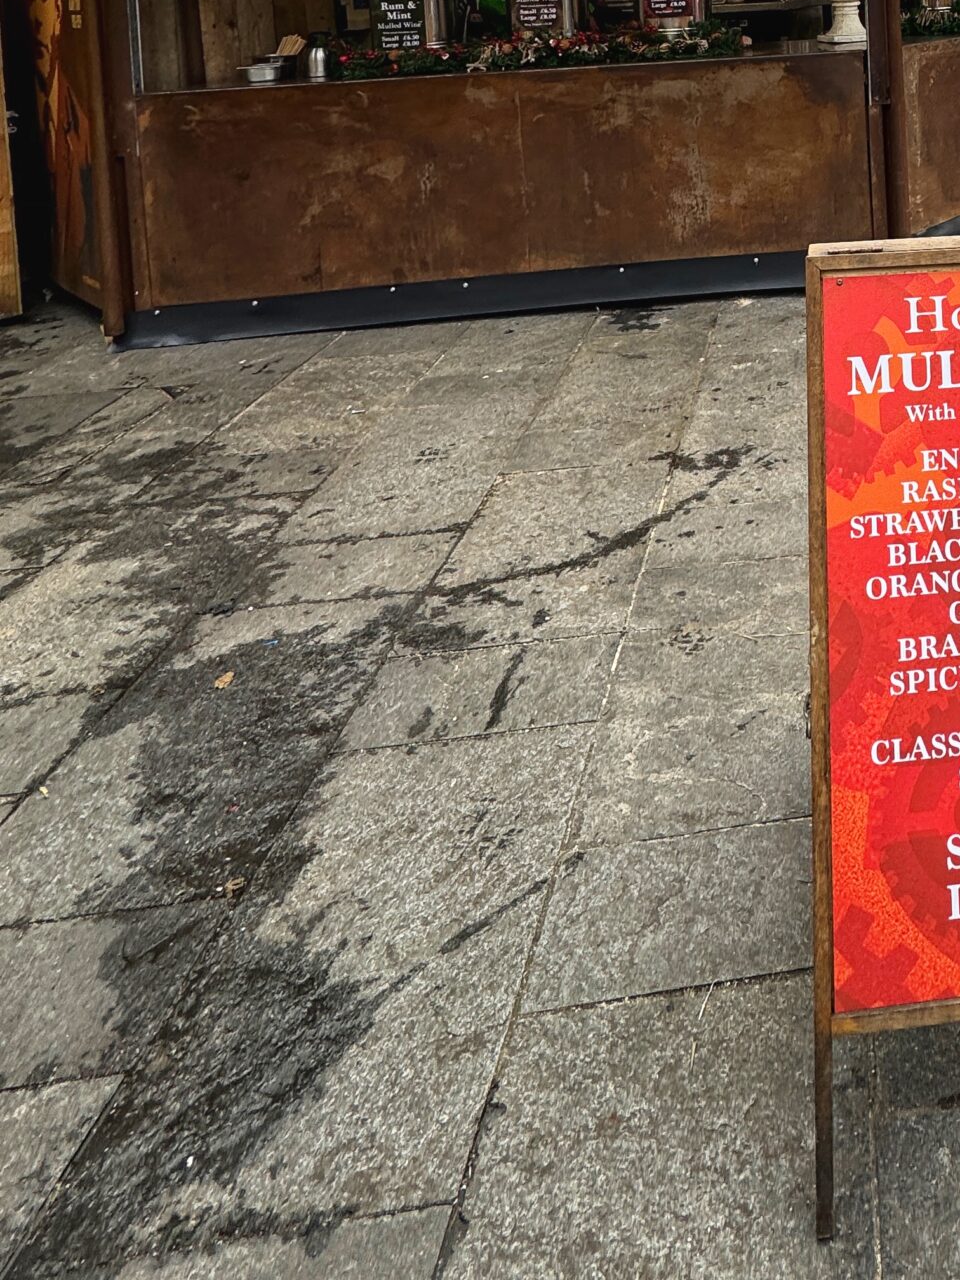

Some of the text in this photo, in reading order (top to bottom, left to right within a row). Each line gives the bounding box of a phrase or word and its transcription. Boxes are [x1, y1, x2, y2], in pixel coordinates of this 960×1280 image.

[381, 1, 416, 10] Rum &
[387, 12, 411, 20] Mint
[904, 402, 956, 423] With
